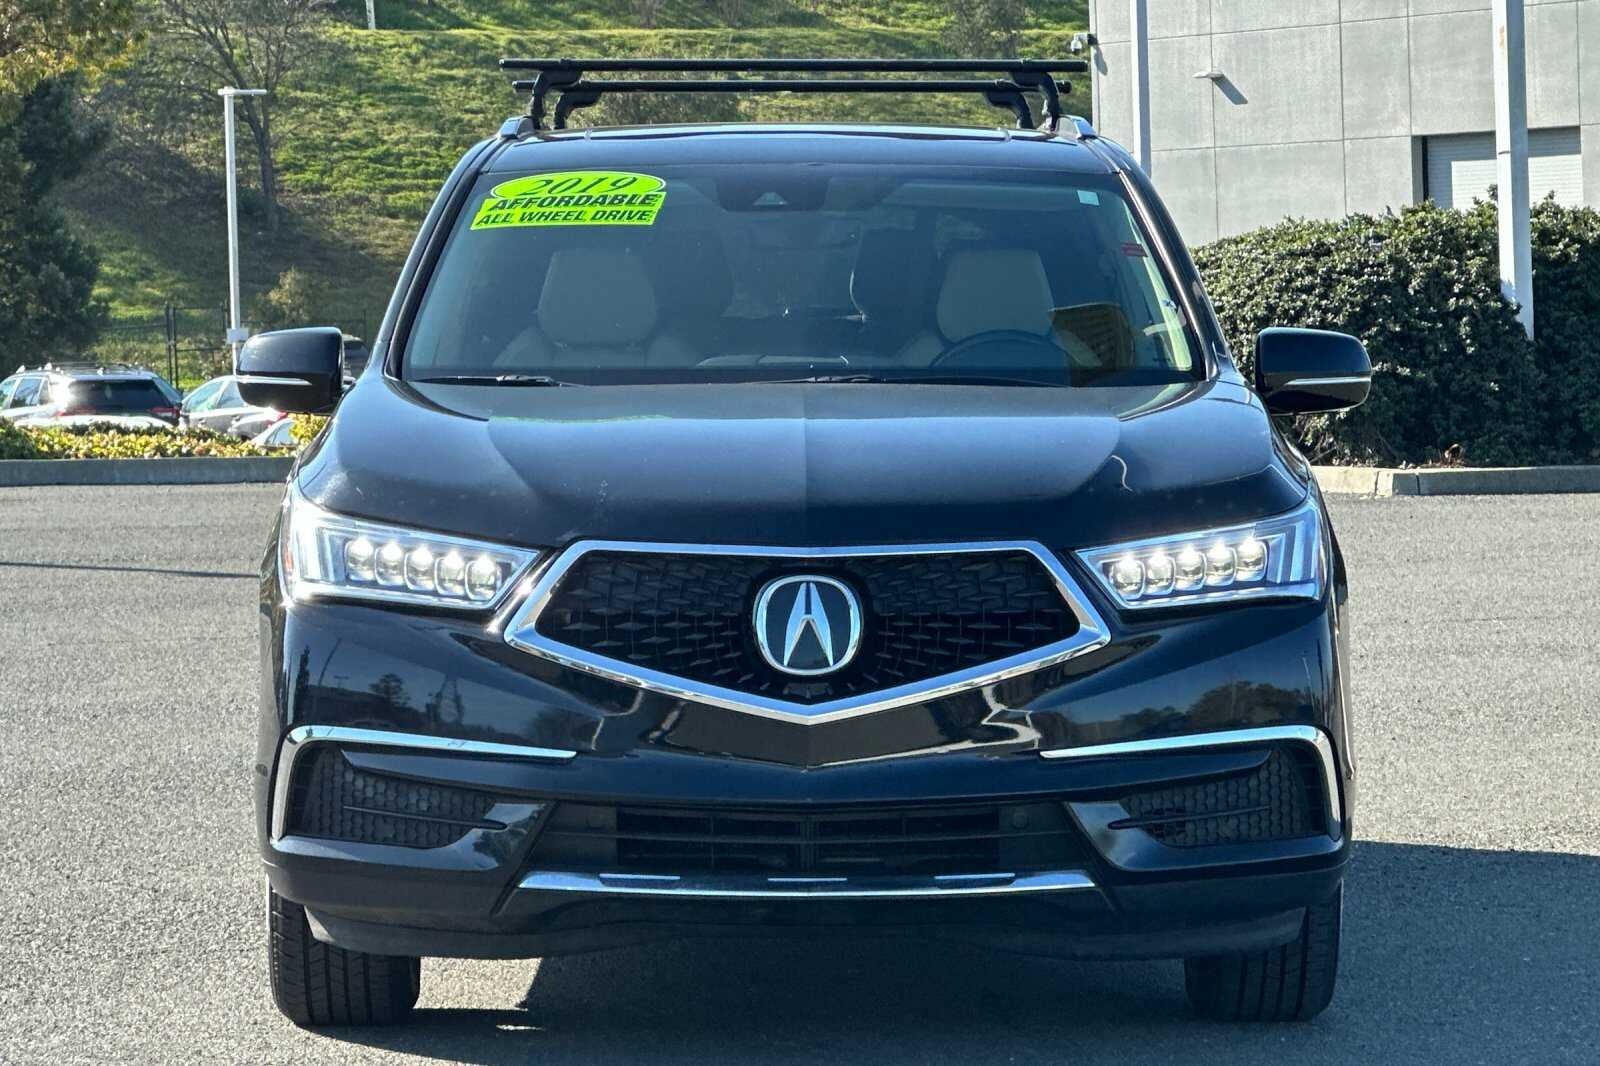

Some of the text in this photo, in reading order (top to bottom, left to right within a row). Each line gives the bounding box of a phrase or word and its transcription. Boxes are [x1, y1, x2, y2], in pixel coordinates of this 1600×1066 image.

[516, 176, 638, 196] 2019
[487, 193, 657, 211] AFFORDABLE
[475, 209, 653, 225] ALL WHEEL DRIVE
